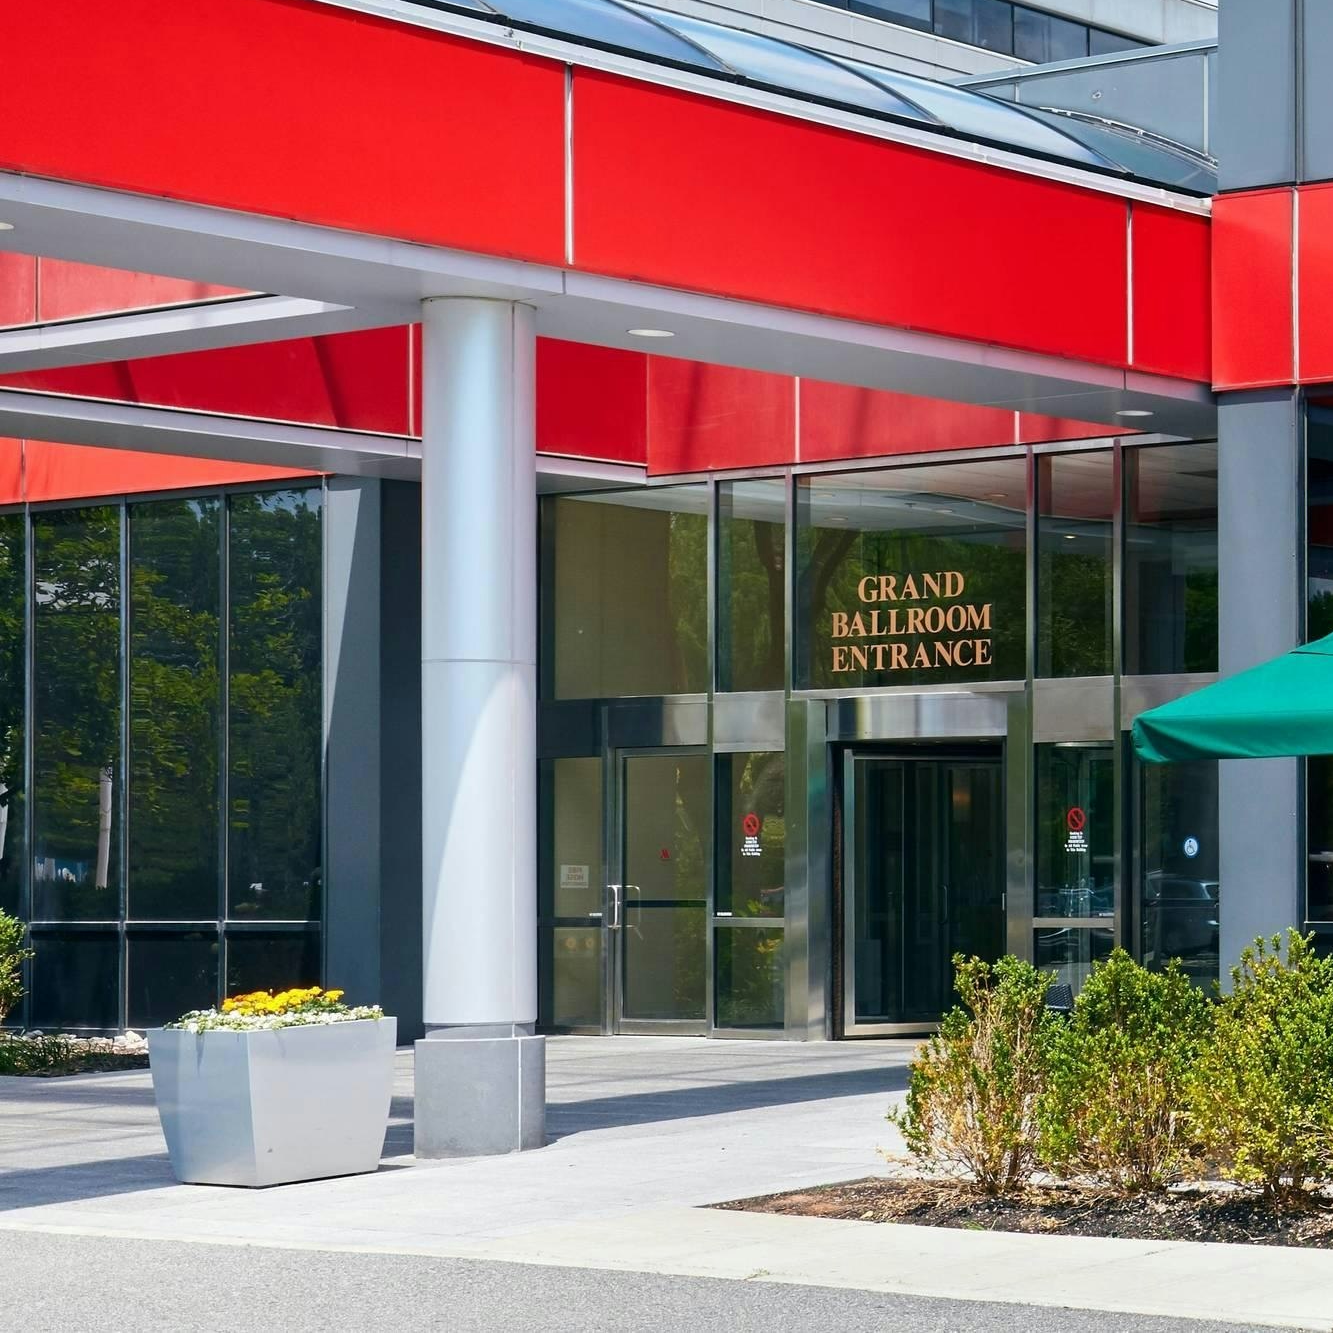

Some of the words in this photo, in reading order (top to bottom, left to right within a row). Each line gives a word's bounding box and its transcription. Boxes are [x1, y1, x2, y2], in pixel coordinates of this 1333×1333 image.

[857, 571, 965, 603] GRAND
[831, 604, 992, 638] BALLROOM
[831, 639, 992, 672] ENTRANCE
